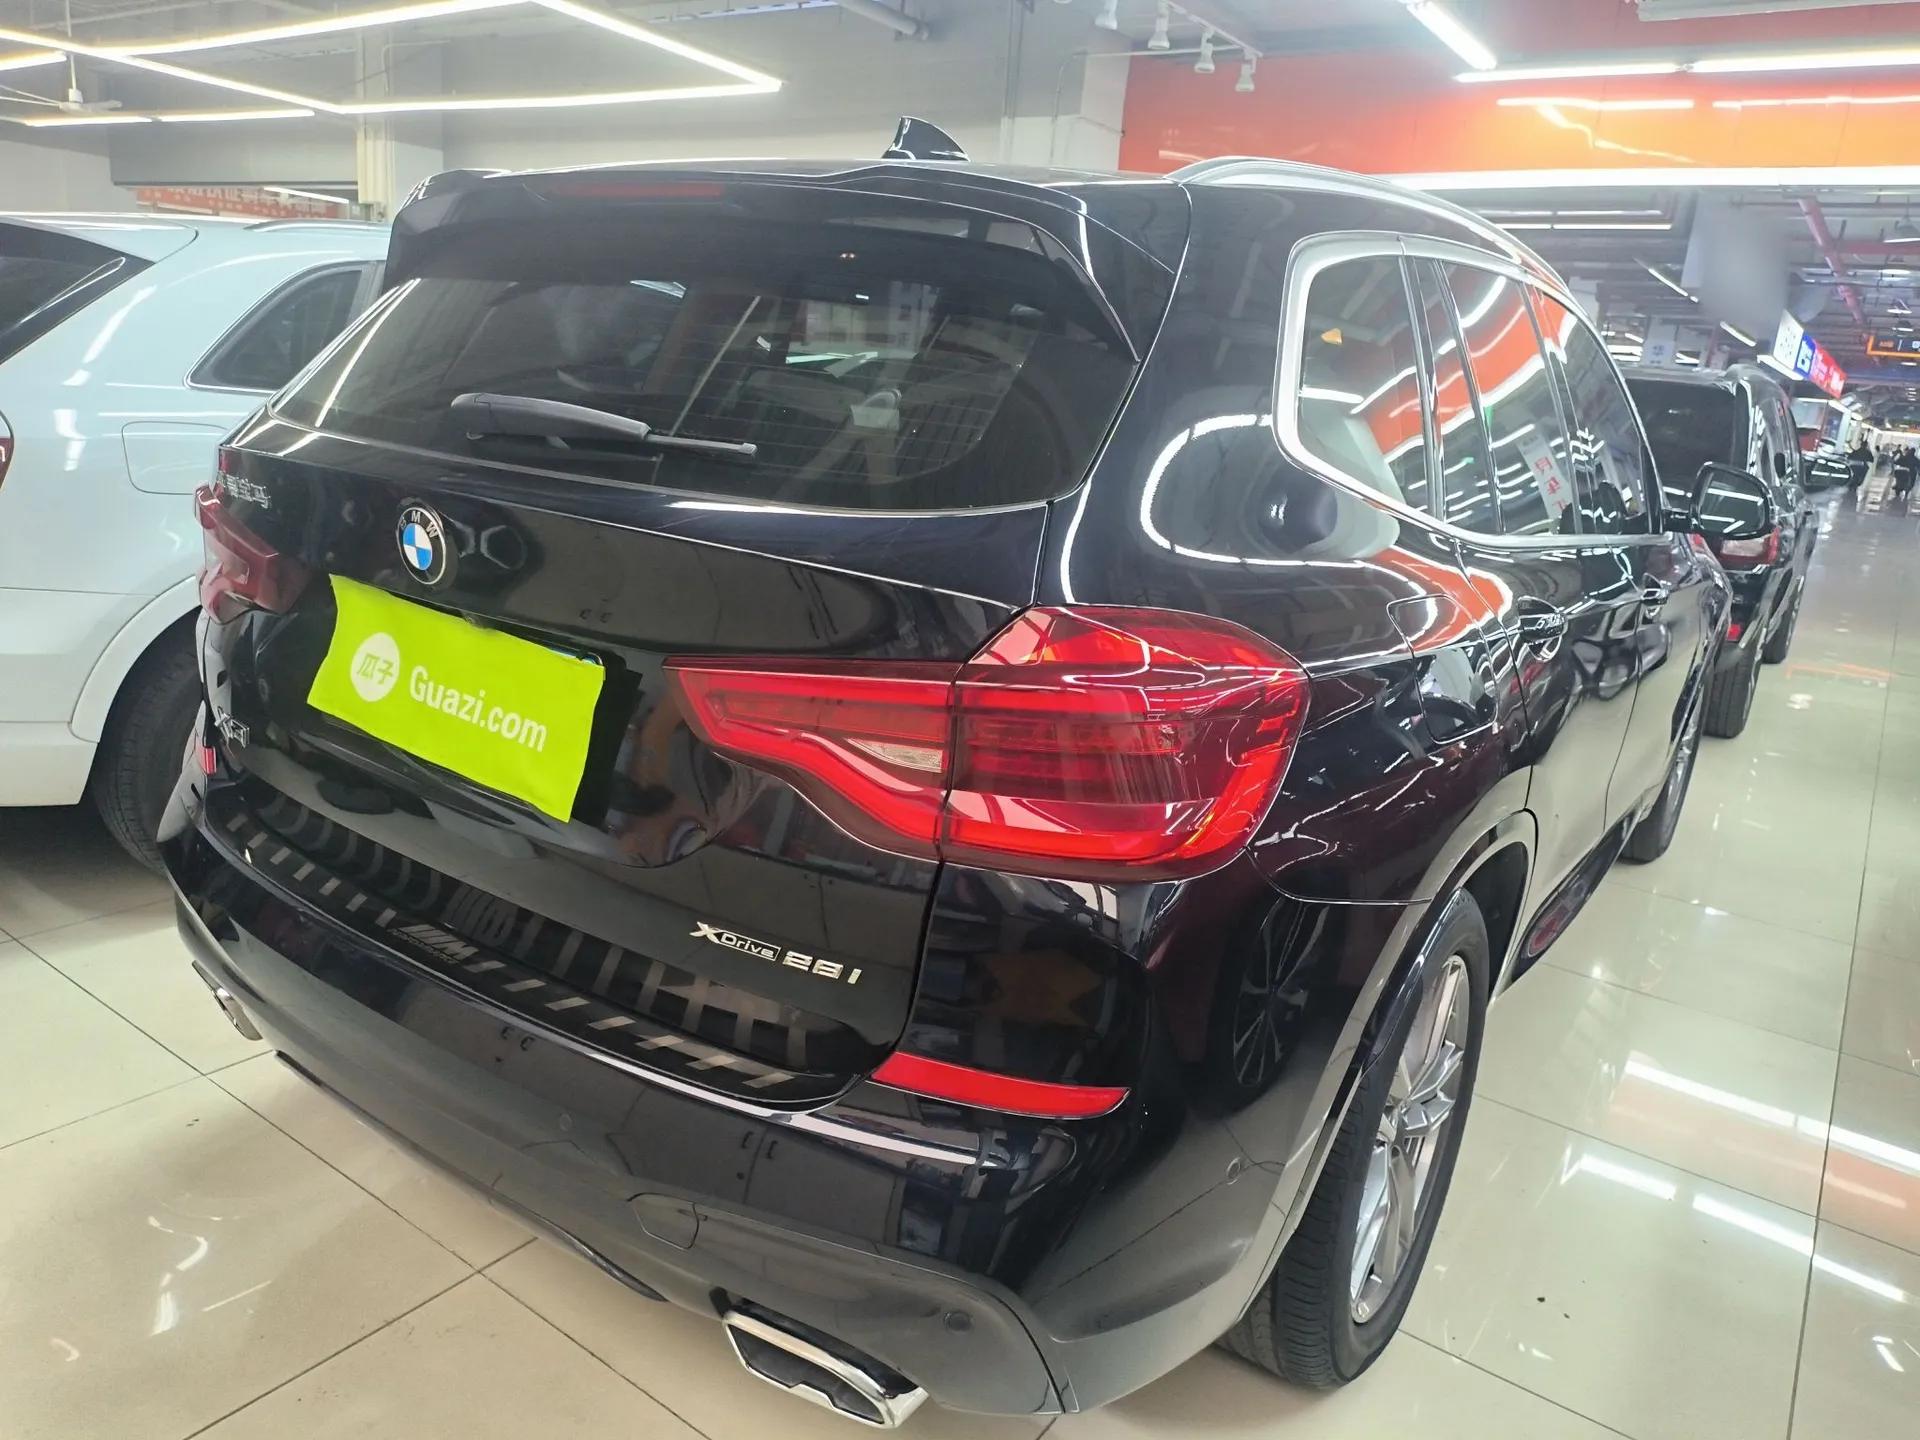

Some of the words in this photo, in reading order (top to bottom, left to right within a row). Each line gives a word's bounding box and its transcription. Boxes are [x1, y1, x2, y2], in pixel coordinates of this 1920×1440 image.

[400, 510, 439, 538] BMW
[357, 653, 394, 685] 瓜子
[409, 665, 547, 752] Guazi.com
